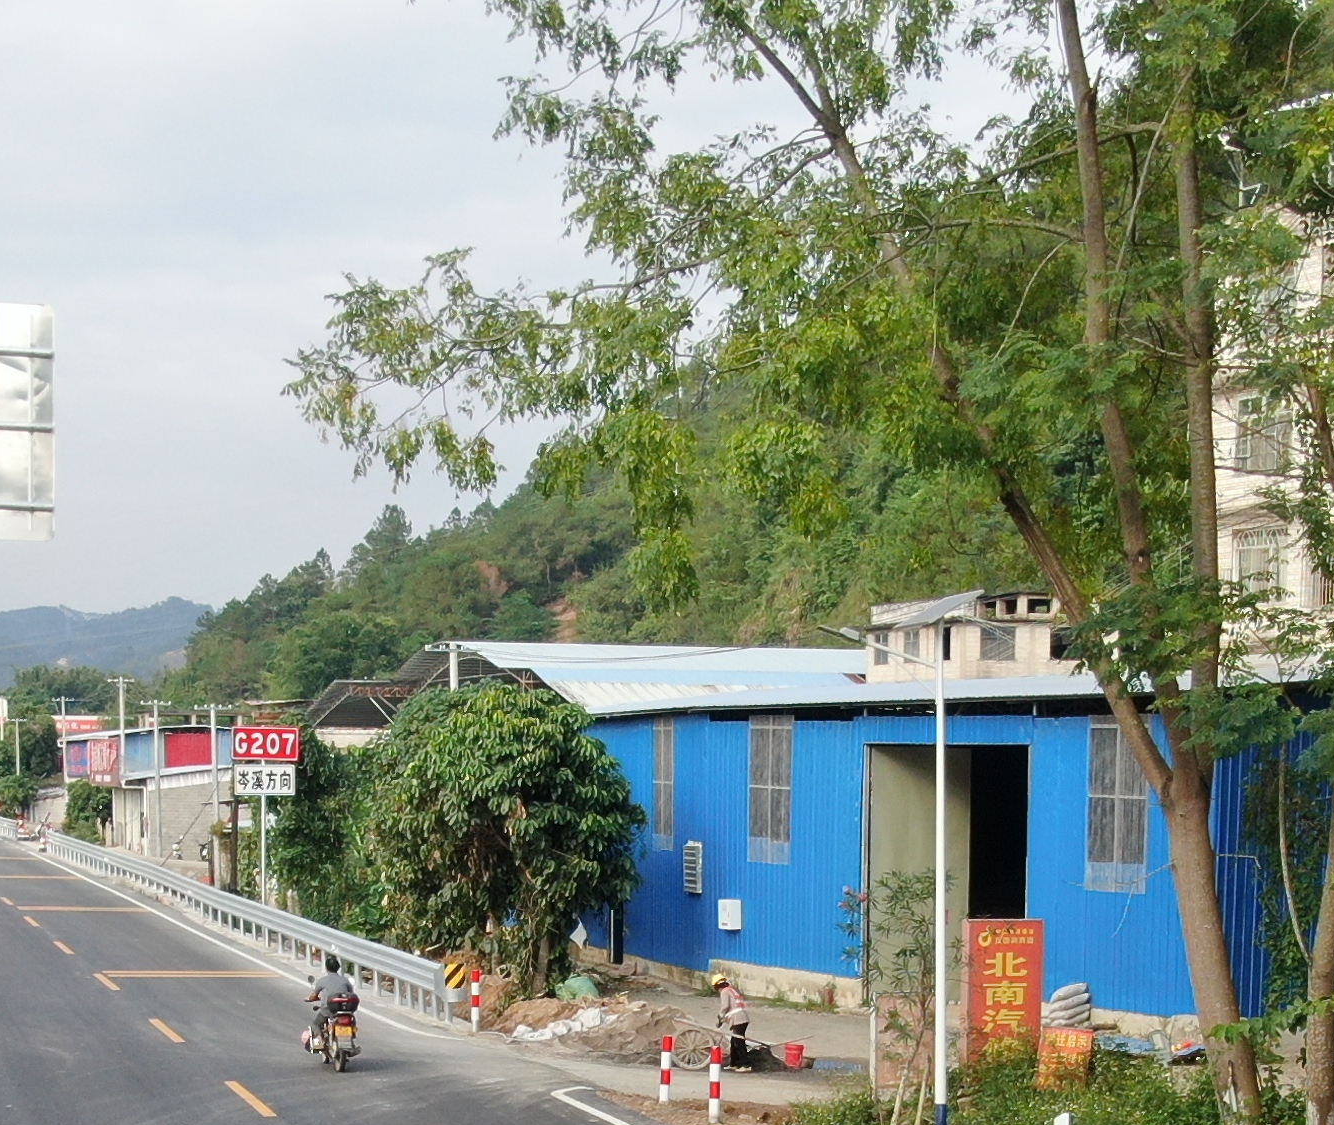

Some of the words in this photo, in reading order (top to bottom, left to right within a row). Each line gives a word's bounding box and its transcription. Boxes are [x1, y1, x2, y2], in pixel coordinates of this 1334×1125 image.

[234, 732, 295, 755] G207
[237, 769, 292, 791] 岑溪方向
